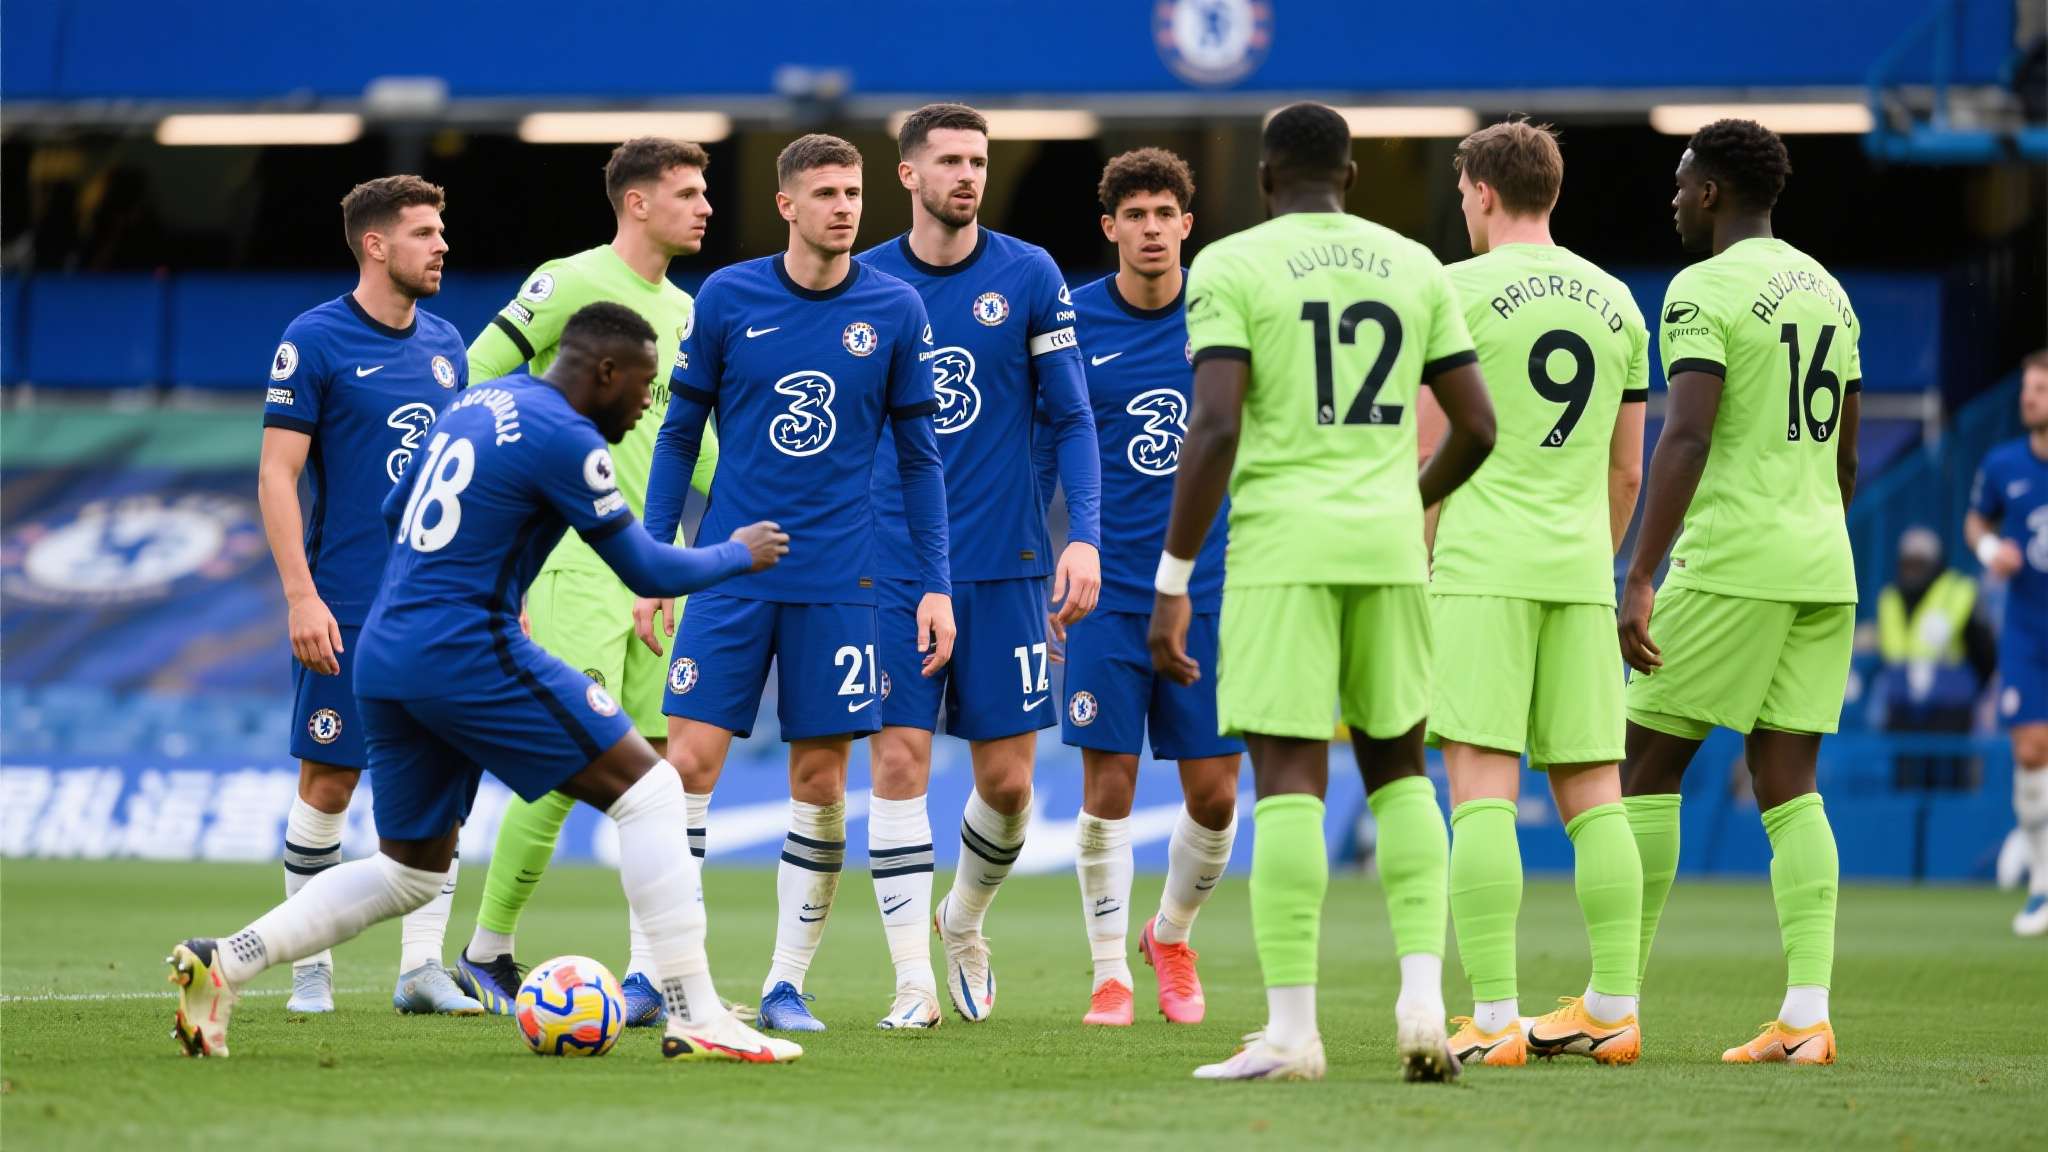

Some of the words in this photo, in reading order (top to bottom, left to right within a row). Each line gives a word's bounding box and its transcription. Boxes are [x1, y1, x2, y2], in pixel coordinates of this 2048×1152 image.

[769, 370, 837, 457] 3
[1300, 300, 1404, 425] 12
[1528, 329, 1596, 447] 9
[1779, 322, 1841, 443] 16
[1126, 388, 1189, 477] 3
[398, 431, 476, 553] 18
[834, 644, 877, 696] 21
[1014, 641, 1049, 694] 17
